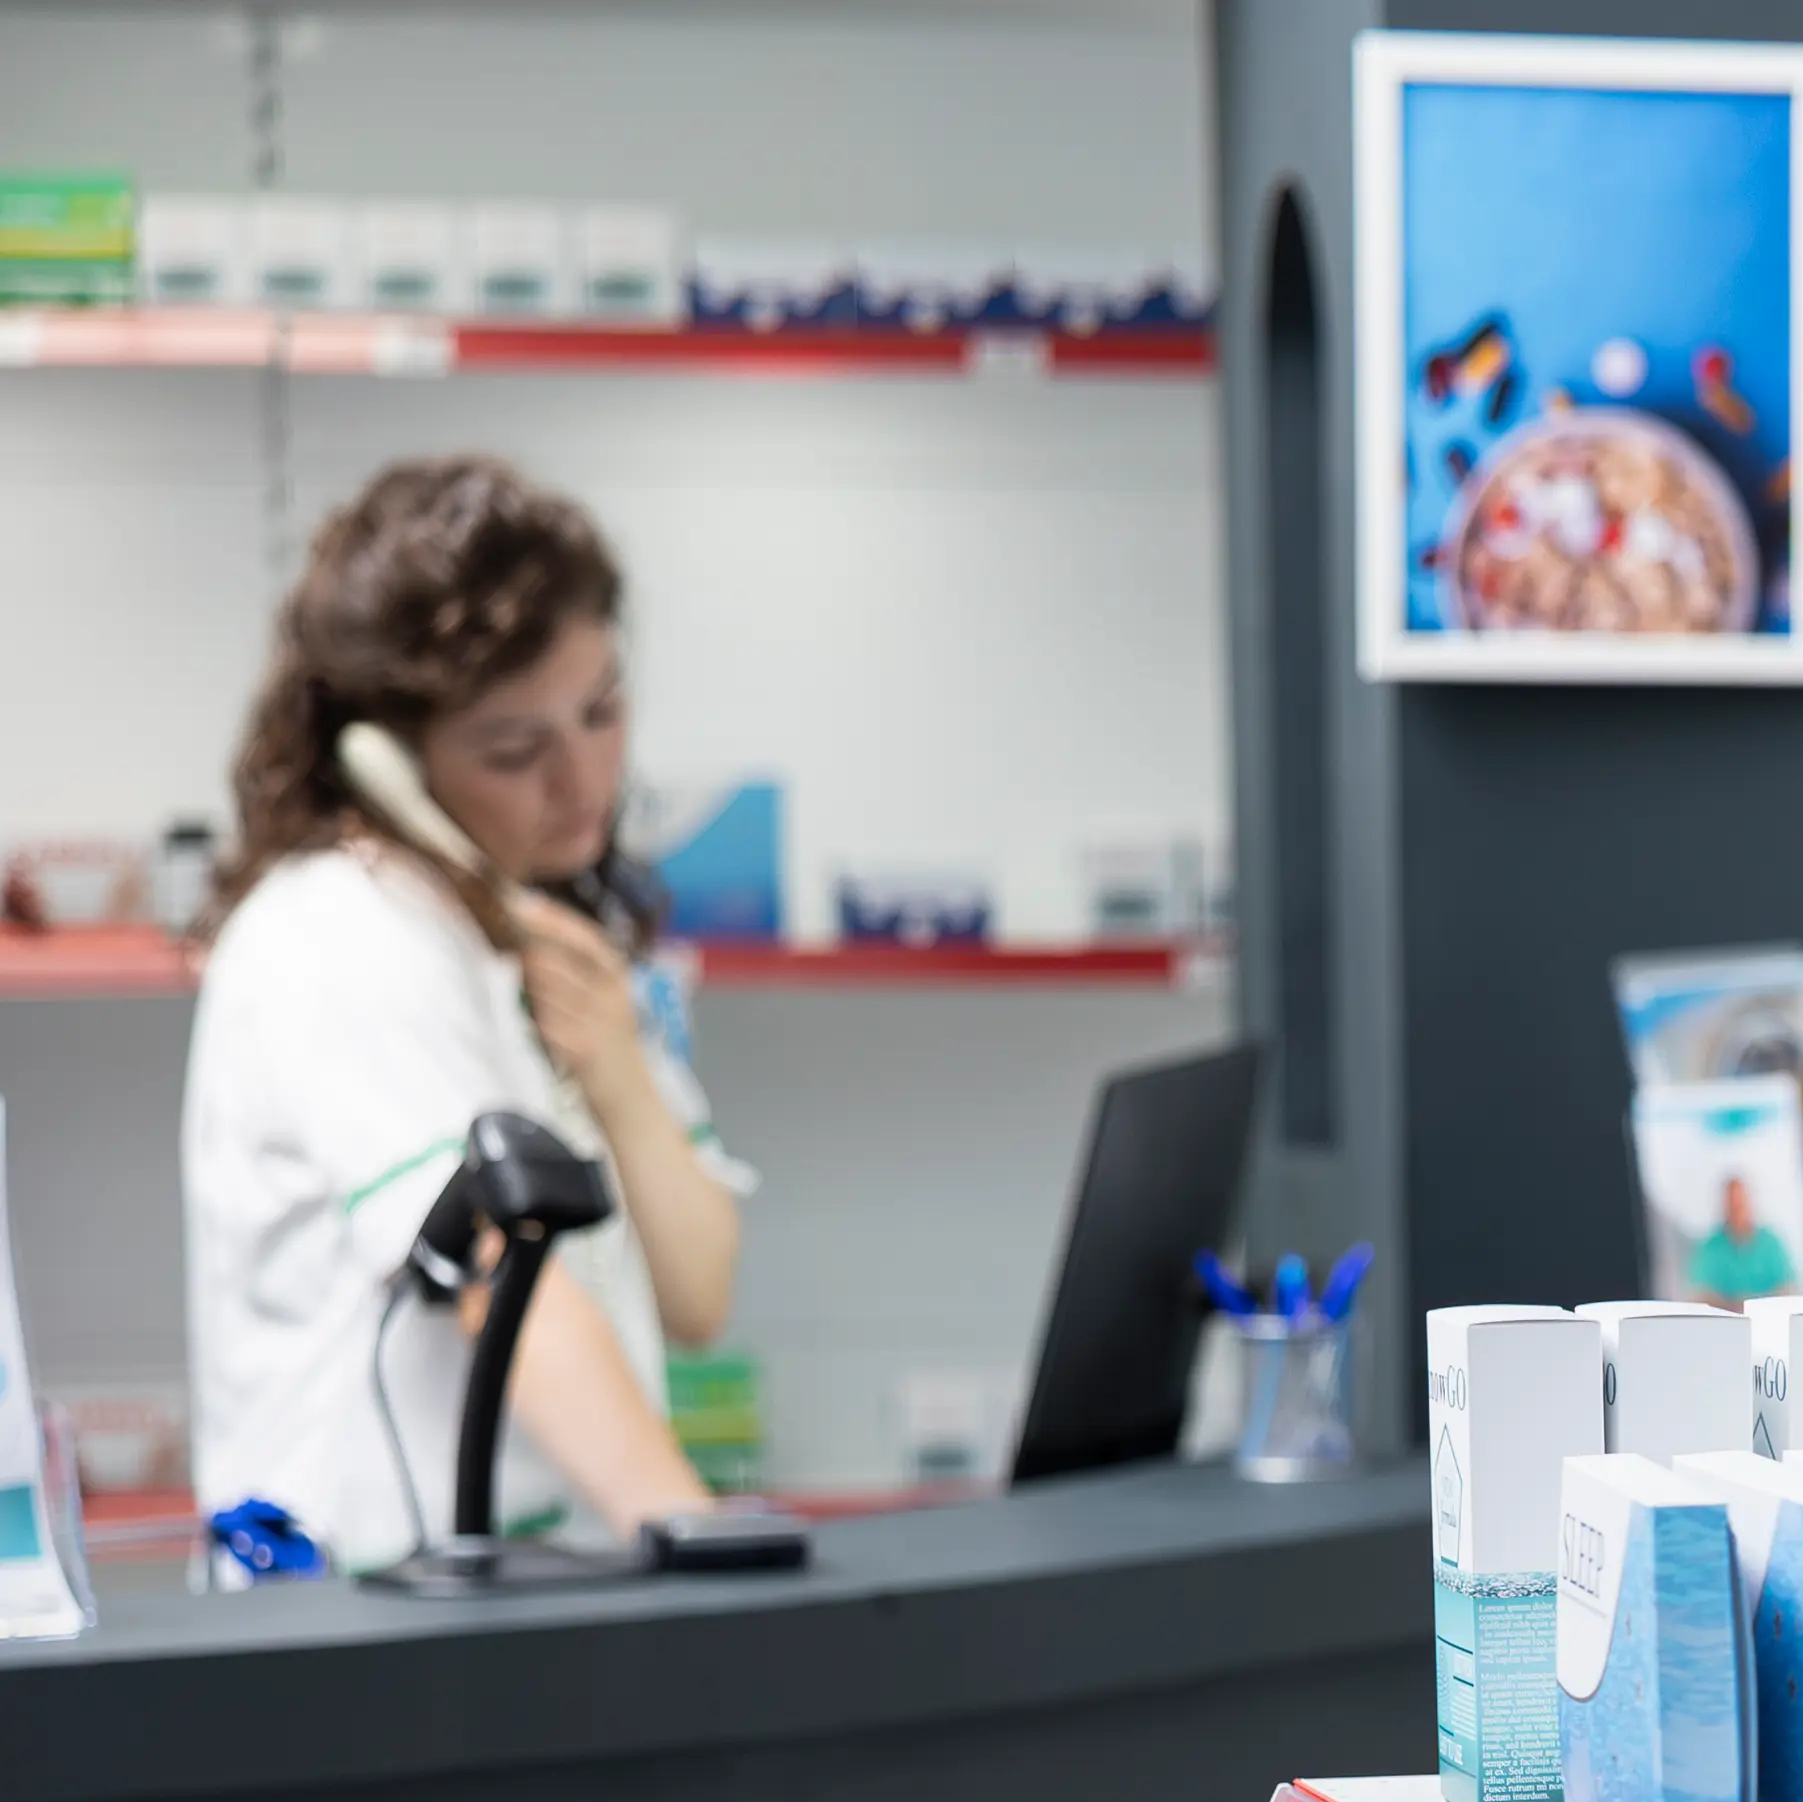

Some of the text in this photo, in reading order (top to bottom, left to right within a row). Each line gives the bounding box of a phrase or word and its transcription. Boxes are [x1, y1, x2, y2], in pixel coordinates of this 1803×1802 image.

[1752, 1356, 1786, 1401] wGO
[1562, 1512, 1605, 1599] SLEEP
[1506, 1775, 1555, 1787] pellentesque
[1483, 1785, 1507, 1793] Fusce
[1508, 1783, 1535, 1792] rutrum
[1483, 1793, 1511, 1802] dictum
